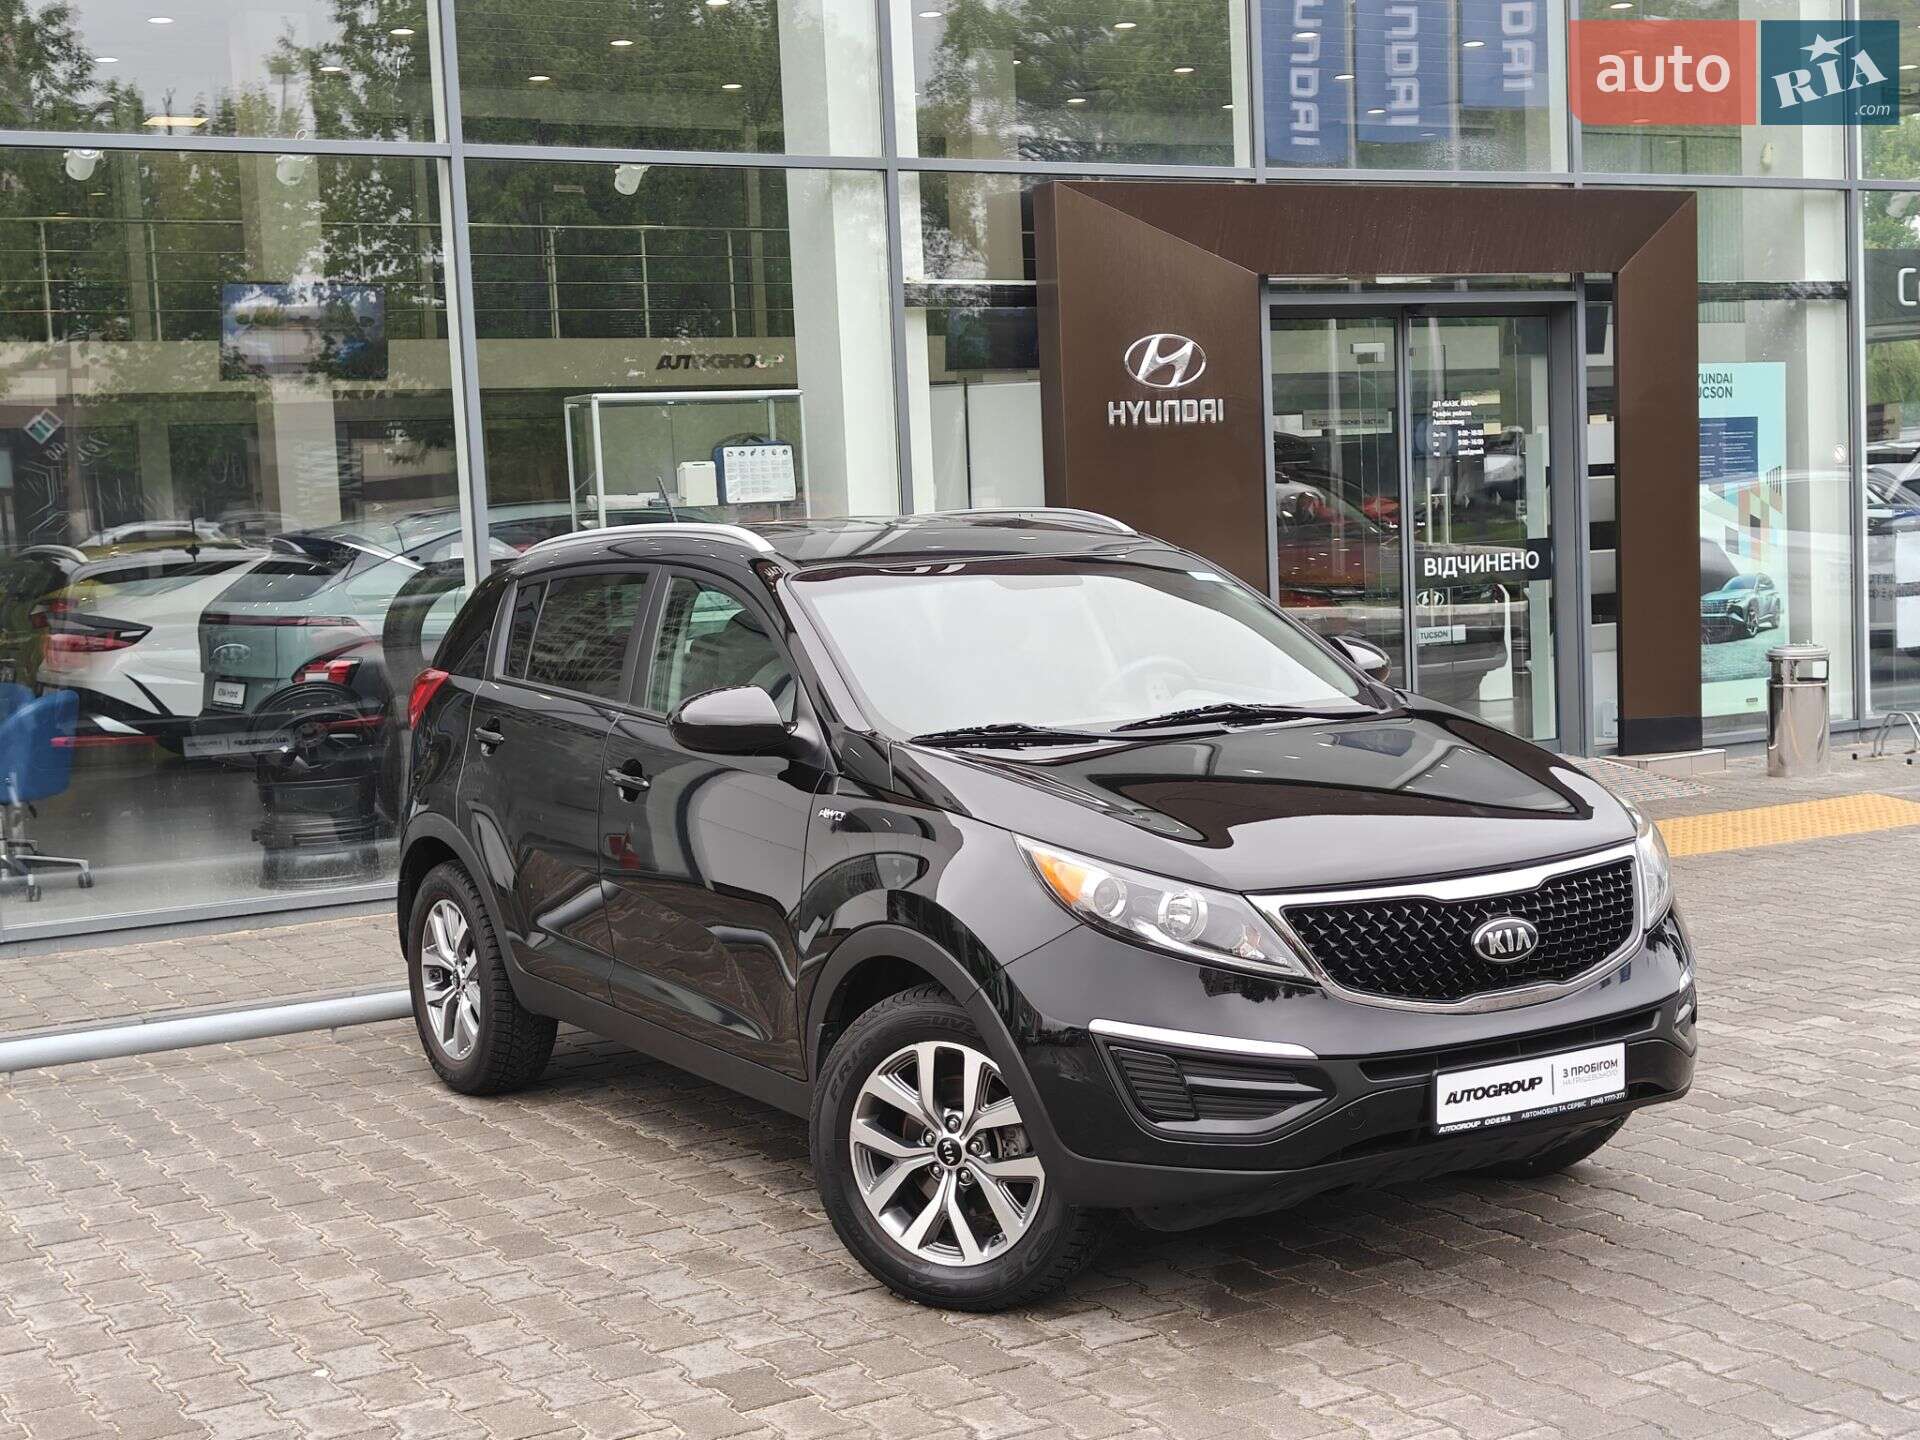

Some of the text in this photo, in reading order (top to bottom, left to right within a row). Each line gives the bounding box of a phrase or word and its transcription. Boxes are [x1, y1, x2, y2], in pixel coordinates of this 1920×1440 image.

[1108, 398, 1224, 426] HYUNDAI
[1423, 550, 1540, 579] ВІДЧИНЕНО
[1486, 926, 1532, 955] KIA
[1571, 1058, 1618, 1077] ПРОБІГОМ
[1444, 1076, 1543, 1106] AUTOGROUP
[1438, 1120, 1481, 1133] AUTOGROUP
[942, 1140, 955, 1164] KIA
